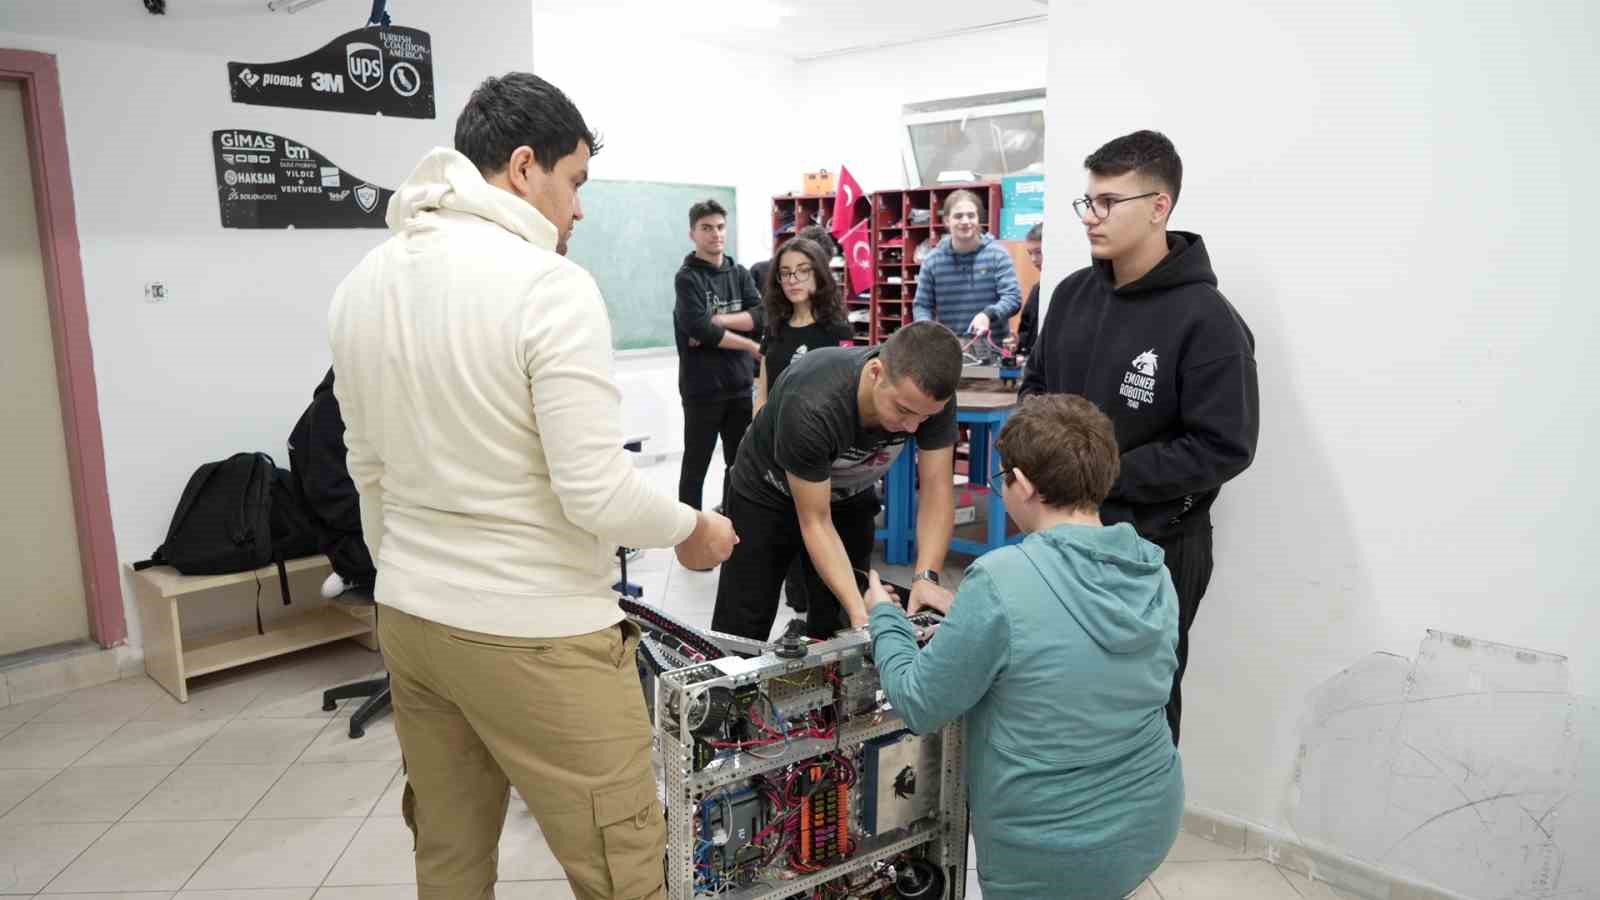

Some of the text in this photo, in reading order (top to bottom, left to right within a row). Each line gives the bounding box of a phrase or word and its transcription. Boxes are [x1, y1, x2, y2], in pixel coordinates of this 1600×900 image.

[380, 32, 411, 43] TURKISH
[389, 48, 423, 59] AMERICA
[350, 56, 380, 83] ups
[311, 72, 344, 93] 3M
[221, 131, 275, 149] GİMAS
[284, 140, 310, 159] bm
[237, 172, 276, 184] HAKSAN
[280, 185, 323, 194] VENTURES
[1119, 383, 1154, 404] ROBOTICS
